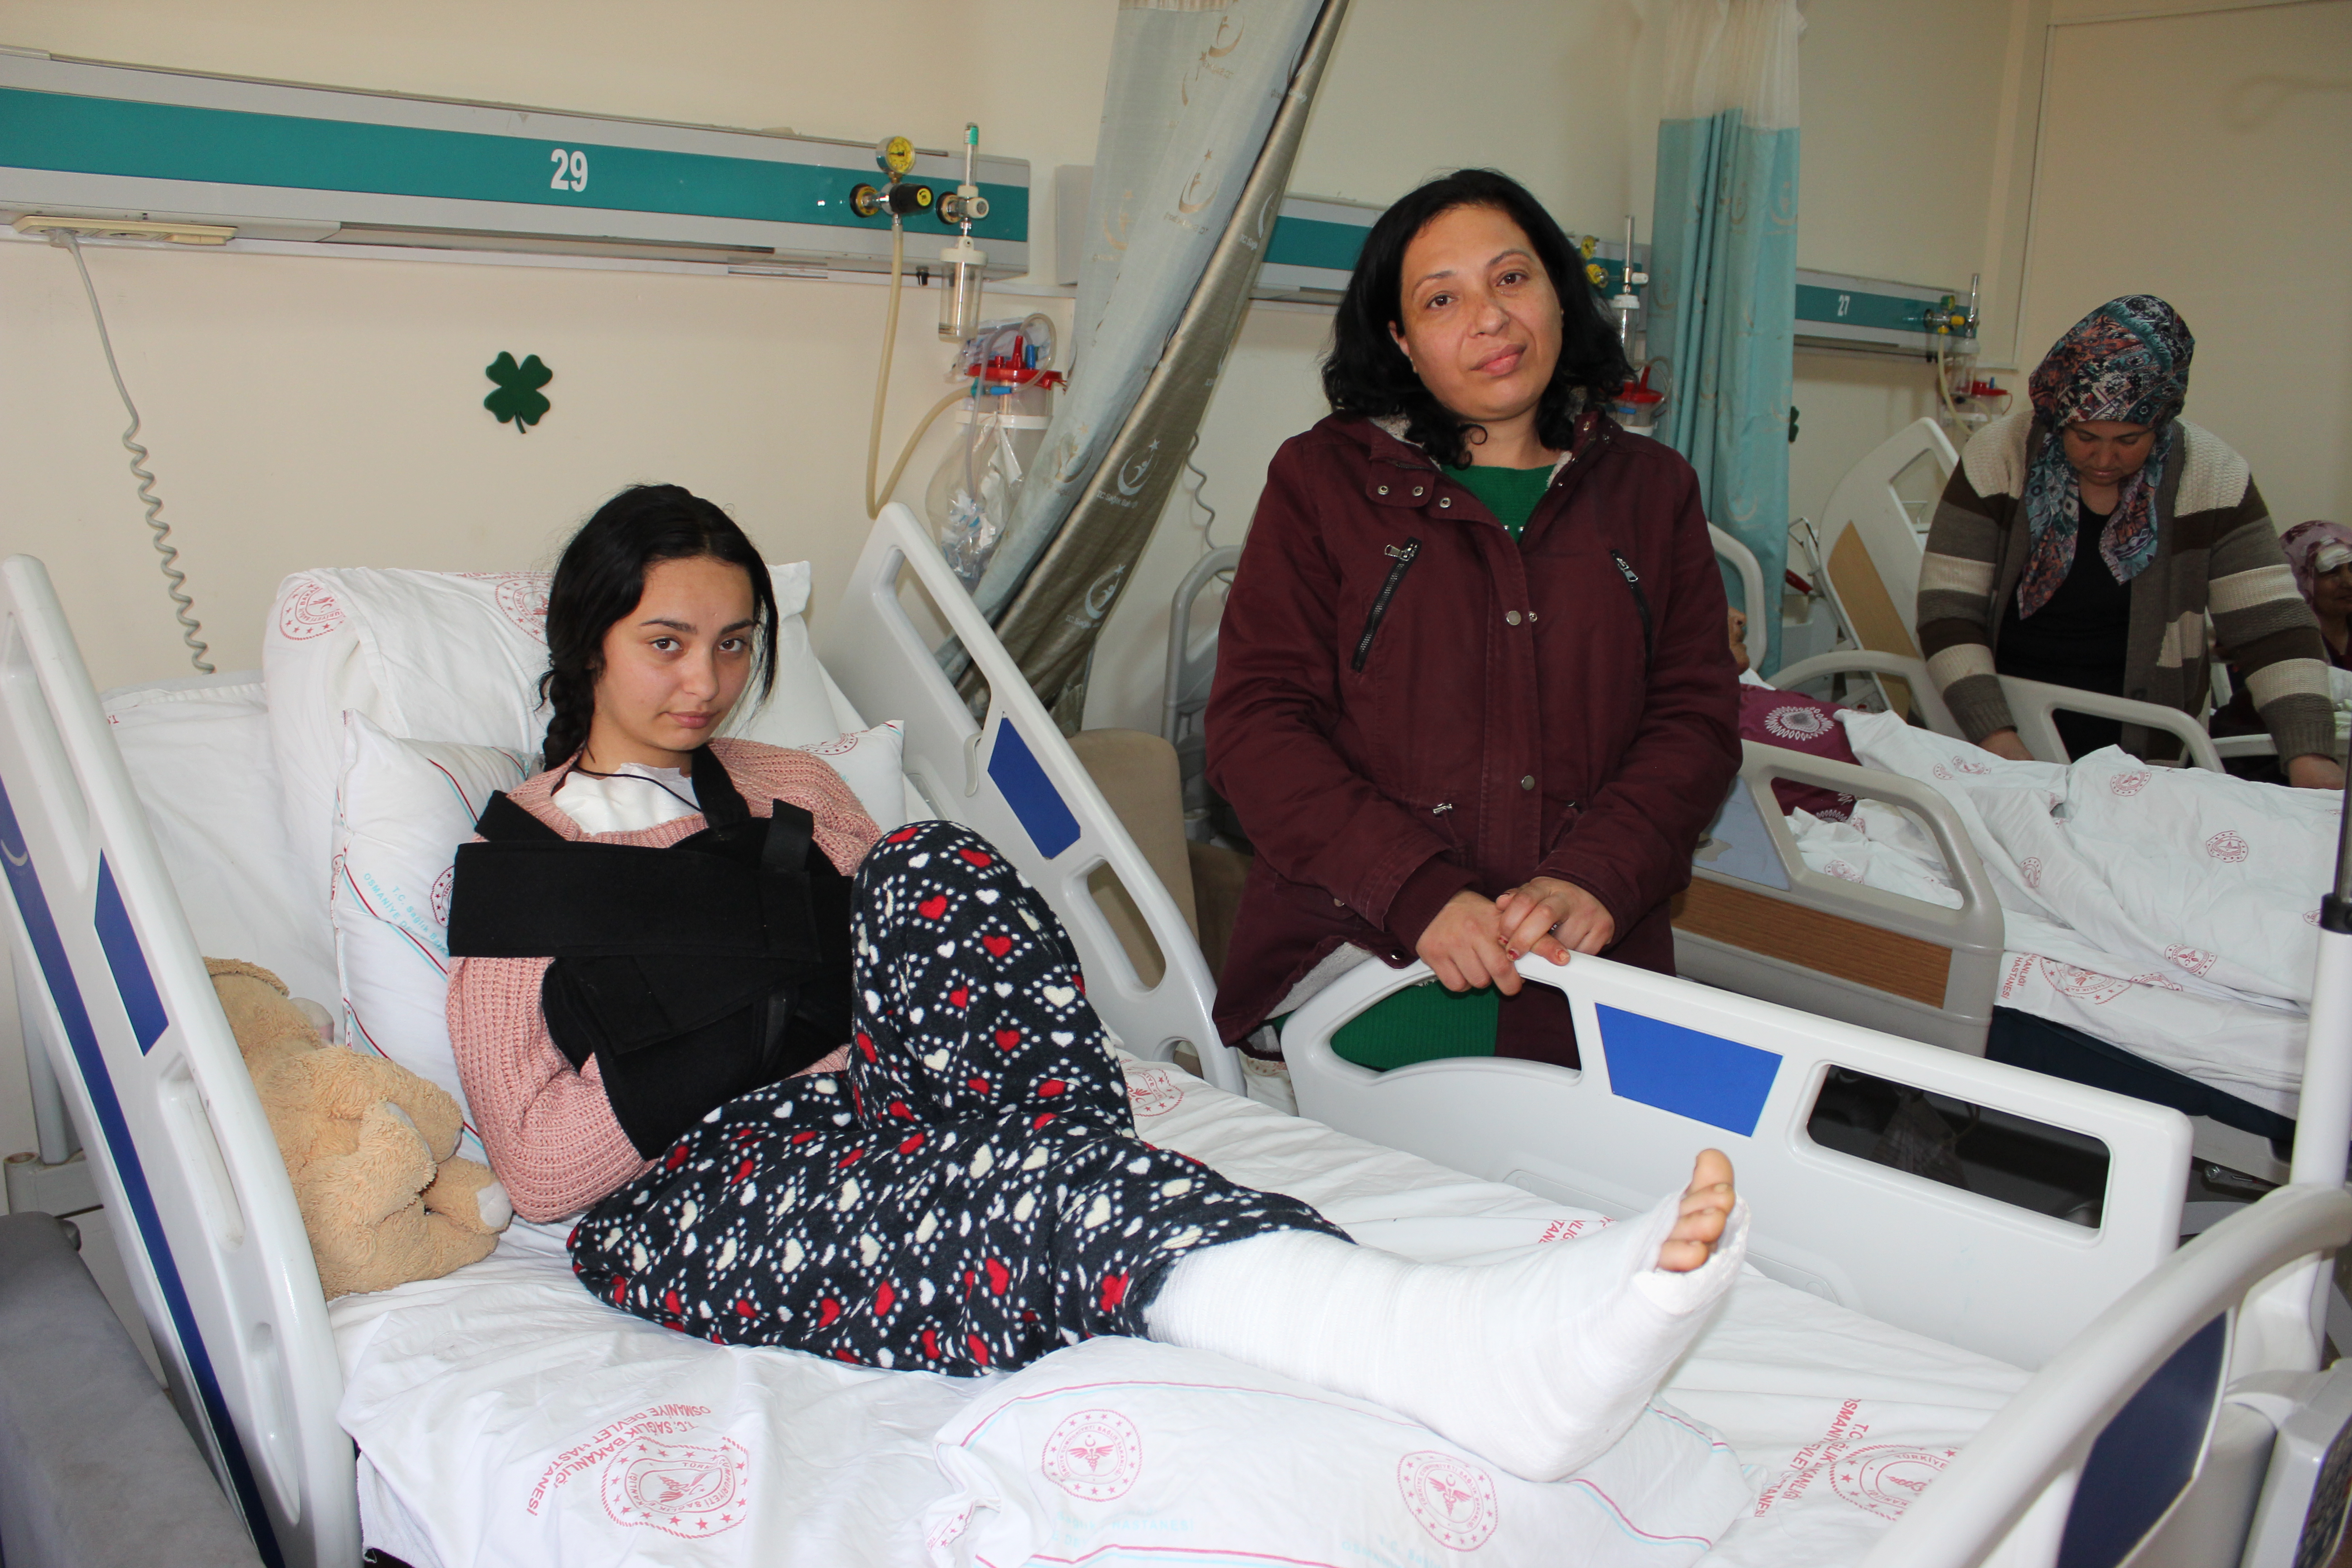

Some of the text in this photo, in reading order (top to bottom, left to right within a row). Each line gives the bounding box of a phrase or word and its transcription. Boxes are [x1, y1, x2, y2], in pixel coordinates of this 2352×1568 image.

[551, 148, 588, 192] 29
[1838, 294, 1850, 316] 27
[363, 873, 400, 920] OSMANİYE
[406, 906, 428, 932] Sağlık
[624, 1421, 674, 1438] SAĞLIK
[526, 1403, 711, 1516] OSMANİYE DEVLET HASTANESİ
